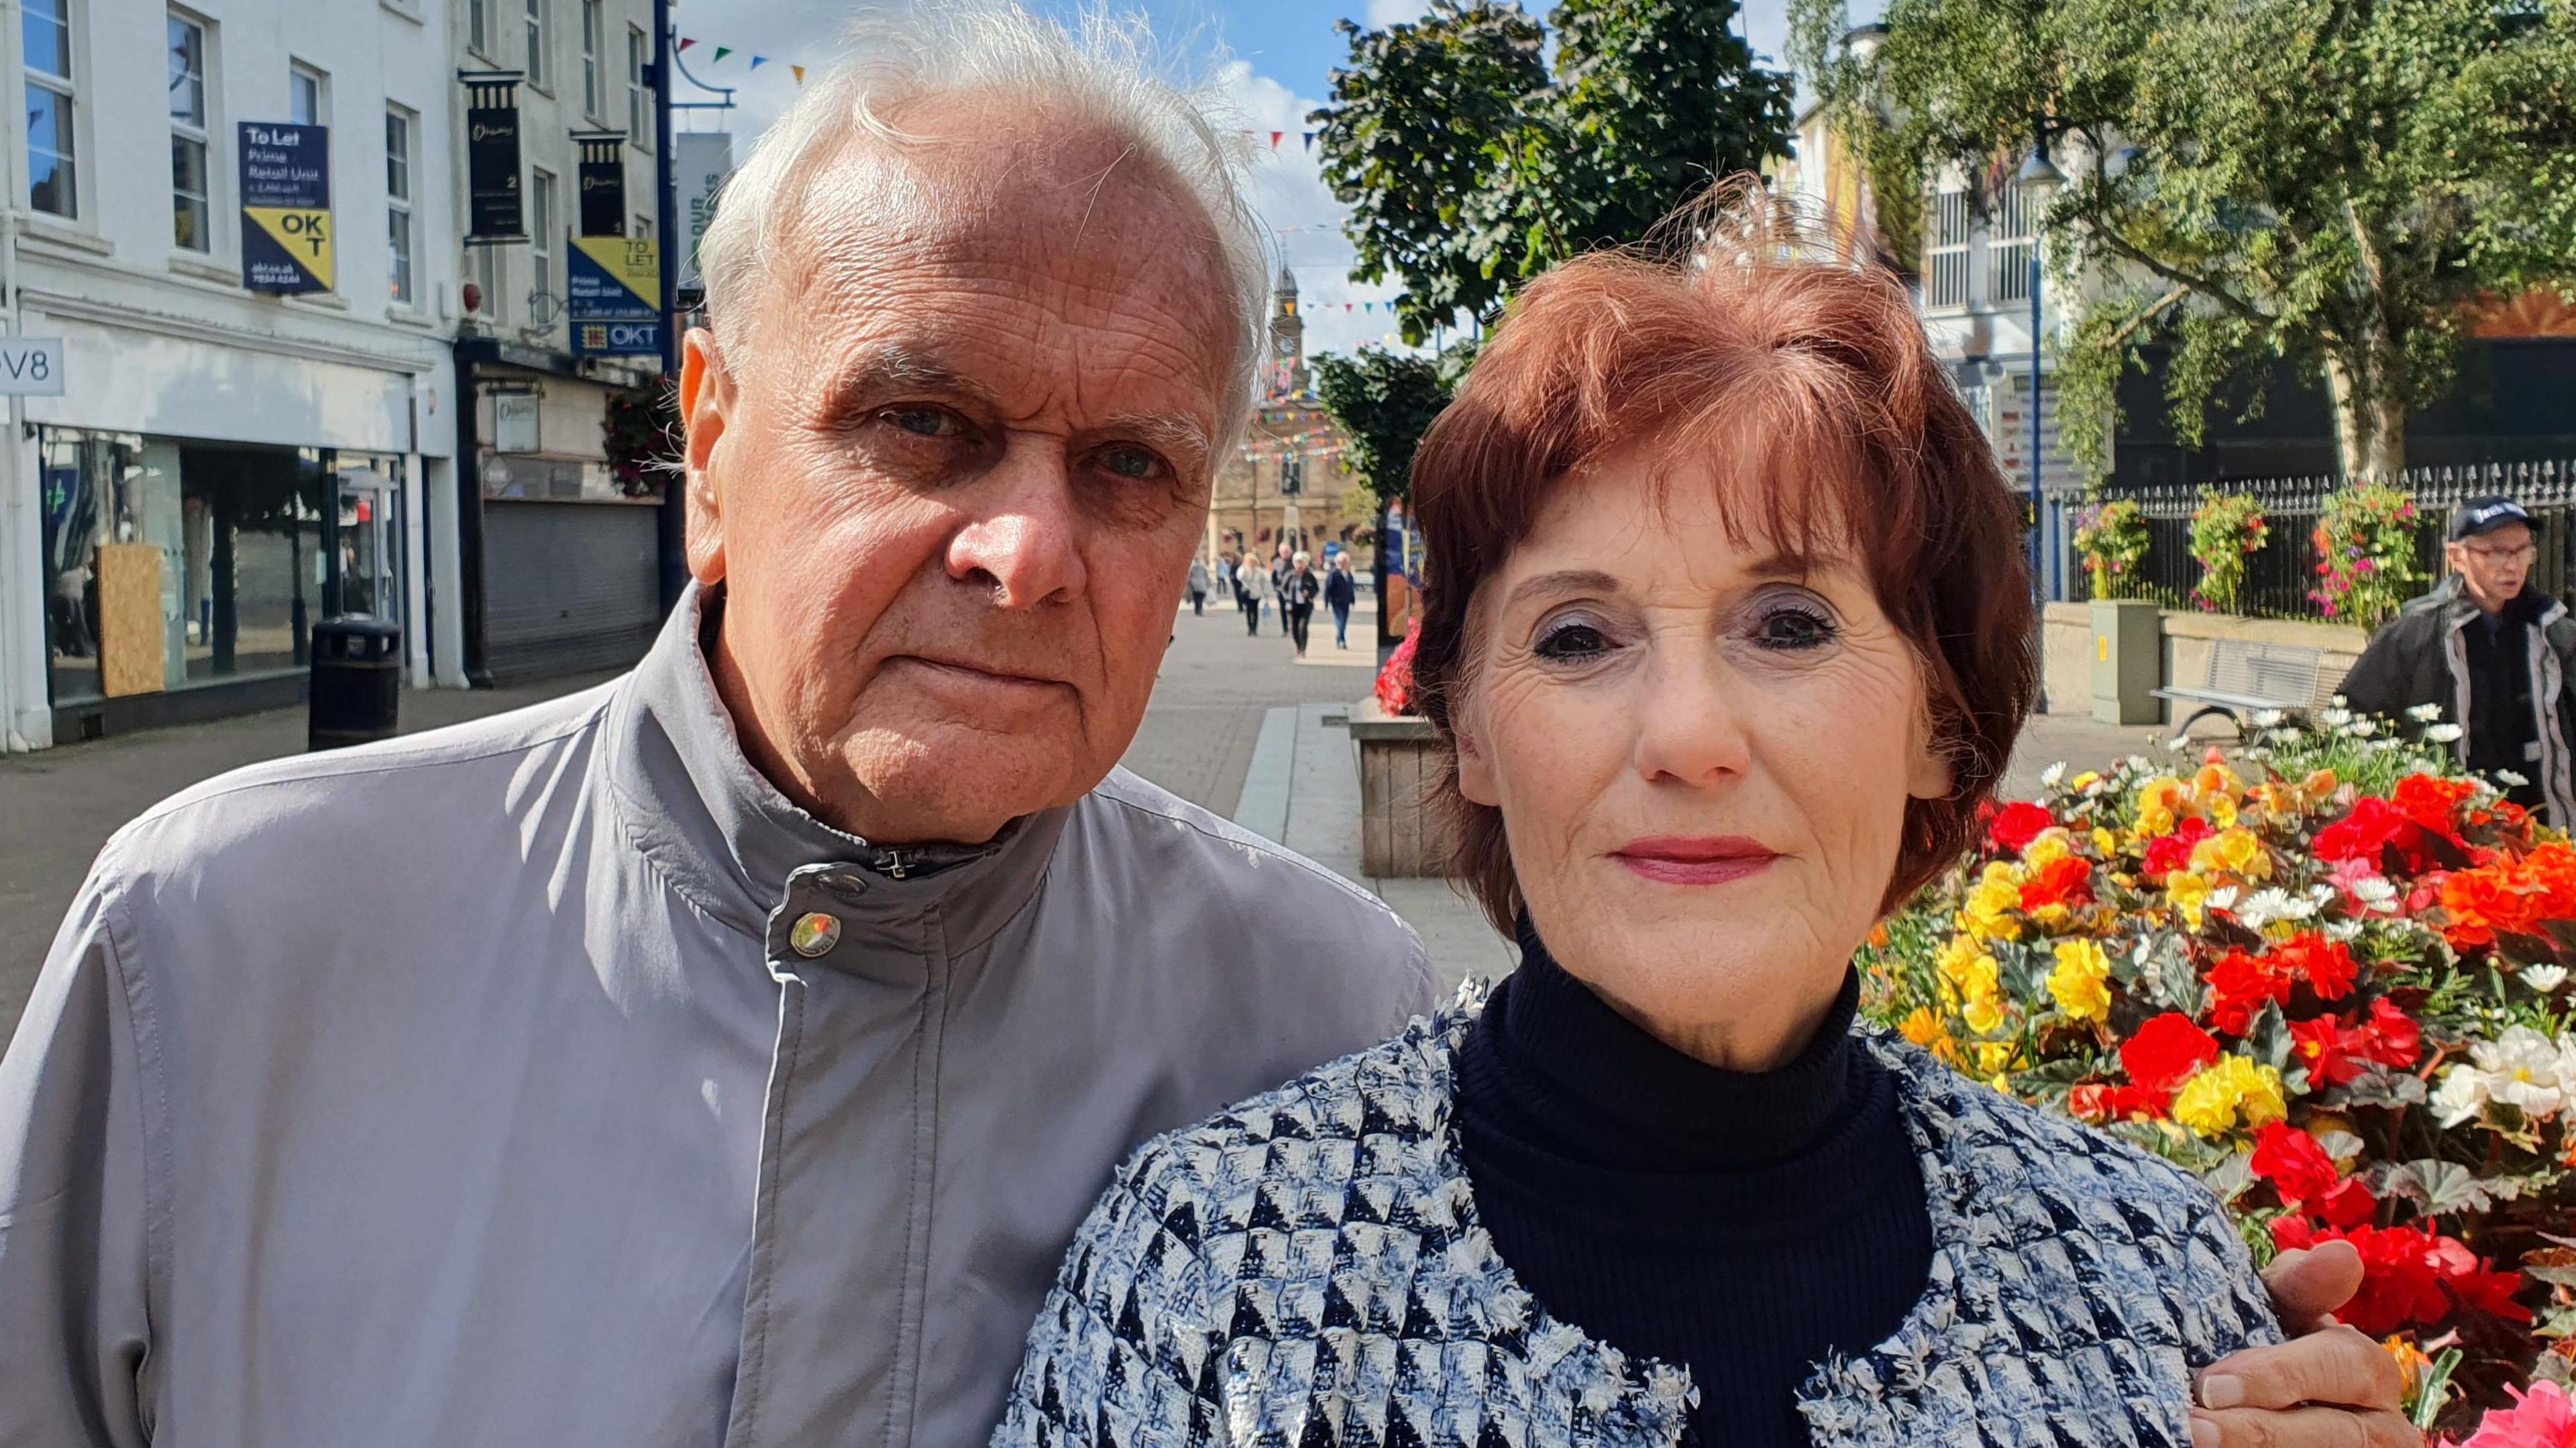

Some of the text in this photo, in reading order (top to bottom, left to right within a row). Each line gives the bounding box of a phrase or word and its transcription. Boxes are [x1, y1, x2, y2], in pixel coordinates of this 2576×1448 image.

[246, 126, 300, 147] To Let
[281, 214, 323, 234] OK
[306, 237, 327, 257] T
[625, 241, 649, 254] TO
[627, 254, 654, 266] LET
[610, 325, 657, 345] OKT
[0, 349, 49, 382] V8
